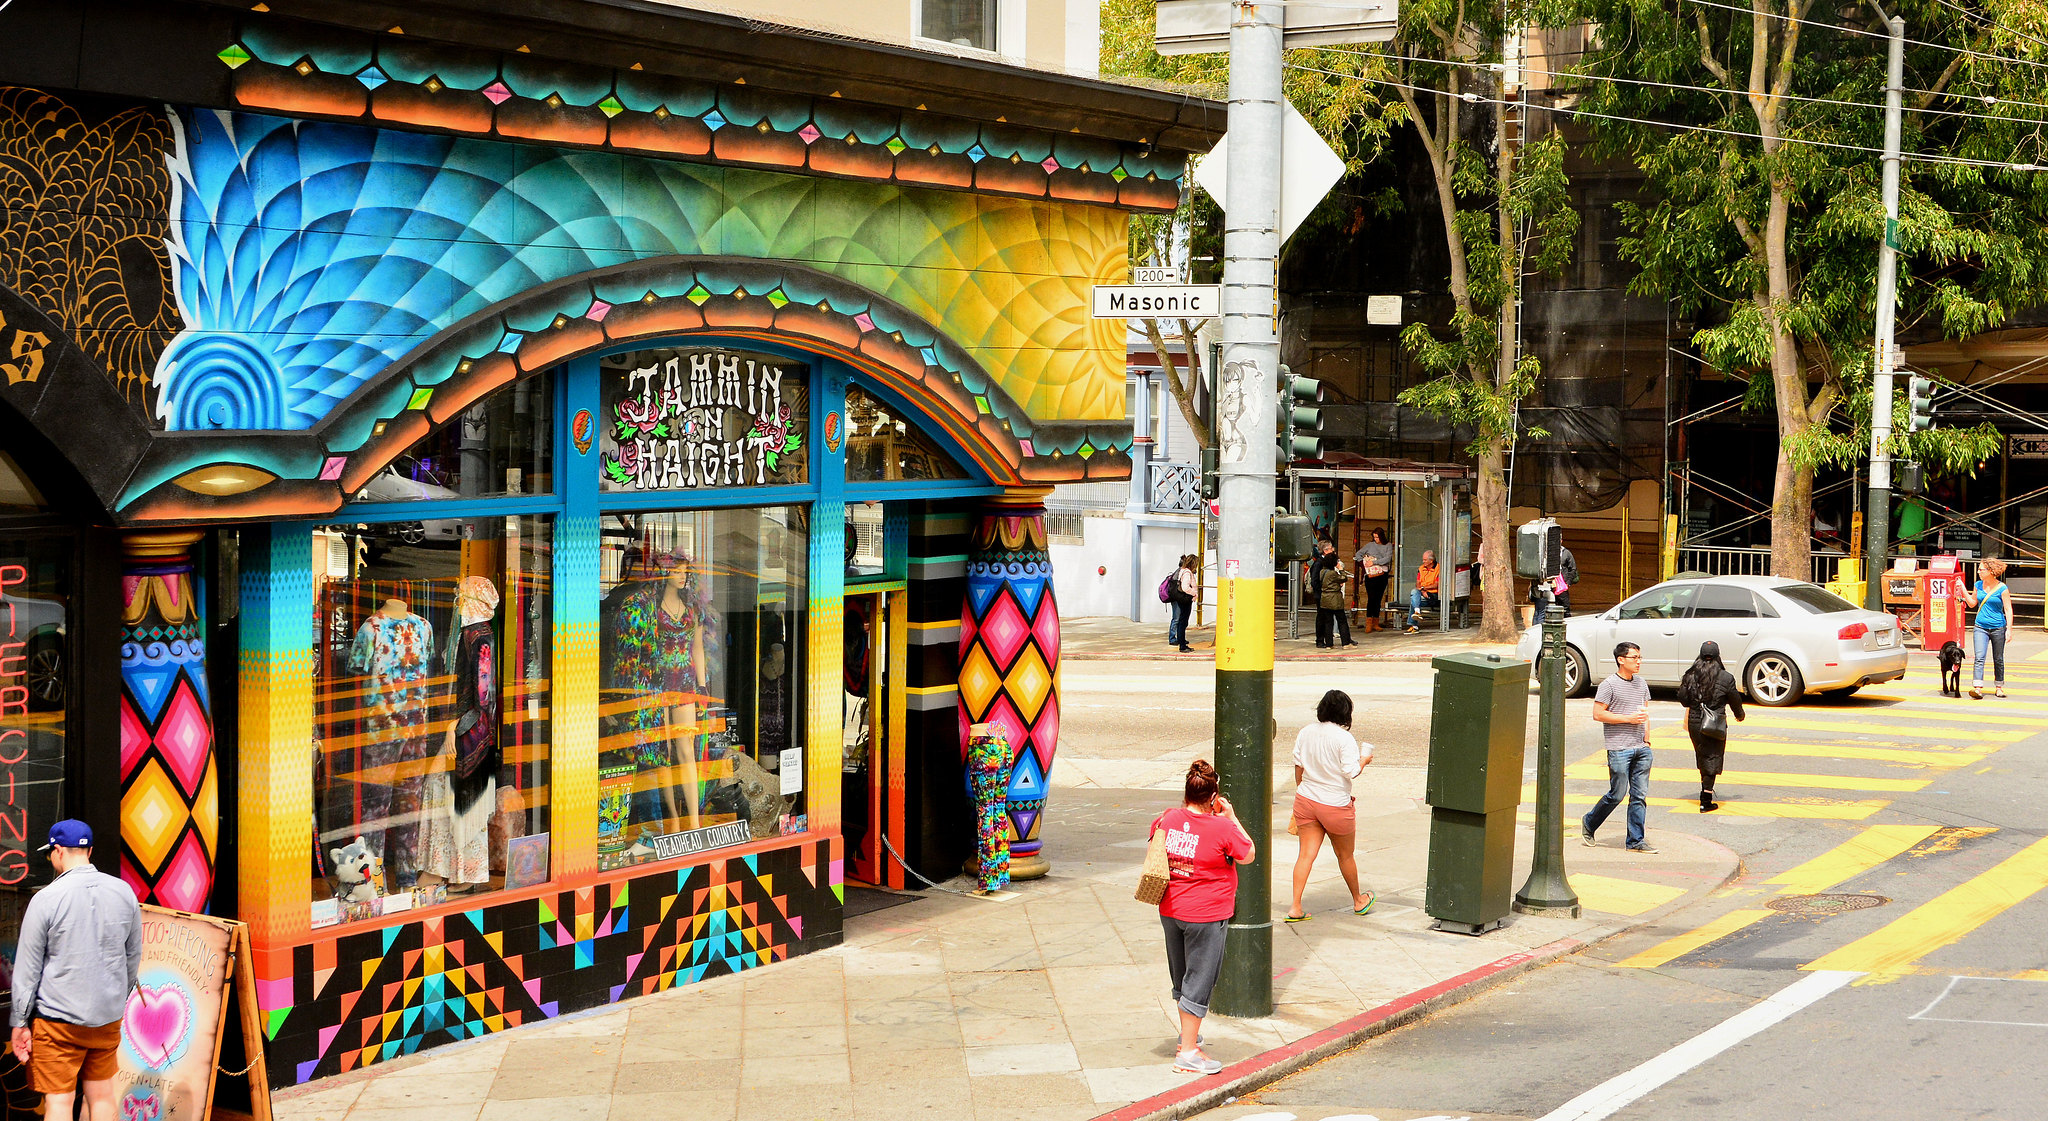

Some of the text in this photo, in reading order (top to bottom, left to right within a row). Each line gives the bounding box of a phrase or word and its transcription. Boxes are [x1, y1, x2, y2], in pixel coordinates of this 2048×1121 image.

[1137, 270, 1164, 282] 1200
[1110, 292, 1200, 310] Masonic
[628, 353, 782, 427] JAMMIN
[635, 435, 774, 488] HAIGHT
[1932, 580, 1945, 595] SF
[0, 564, 29, 885] PIERCING
[659, 823, 746, 857] DEADHEAD COUNTRY
[1167, 828, 1200, 844] FRIENDS
[141, 921, 219, 978] TOO PIERCING
[147, 950, 166, 962] AND
[167, 951, 208, 991] FRIENDLY
[118, 1070, 174, 1092] OPEN LATE
